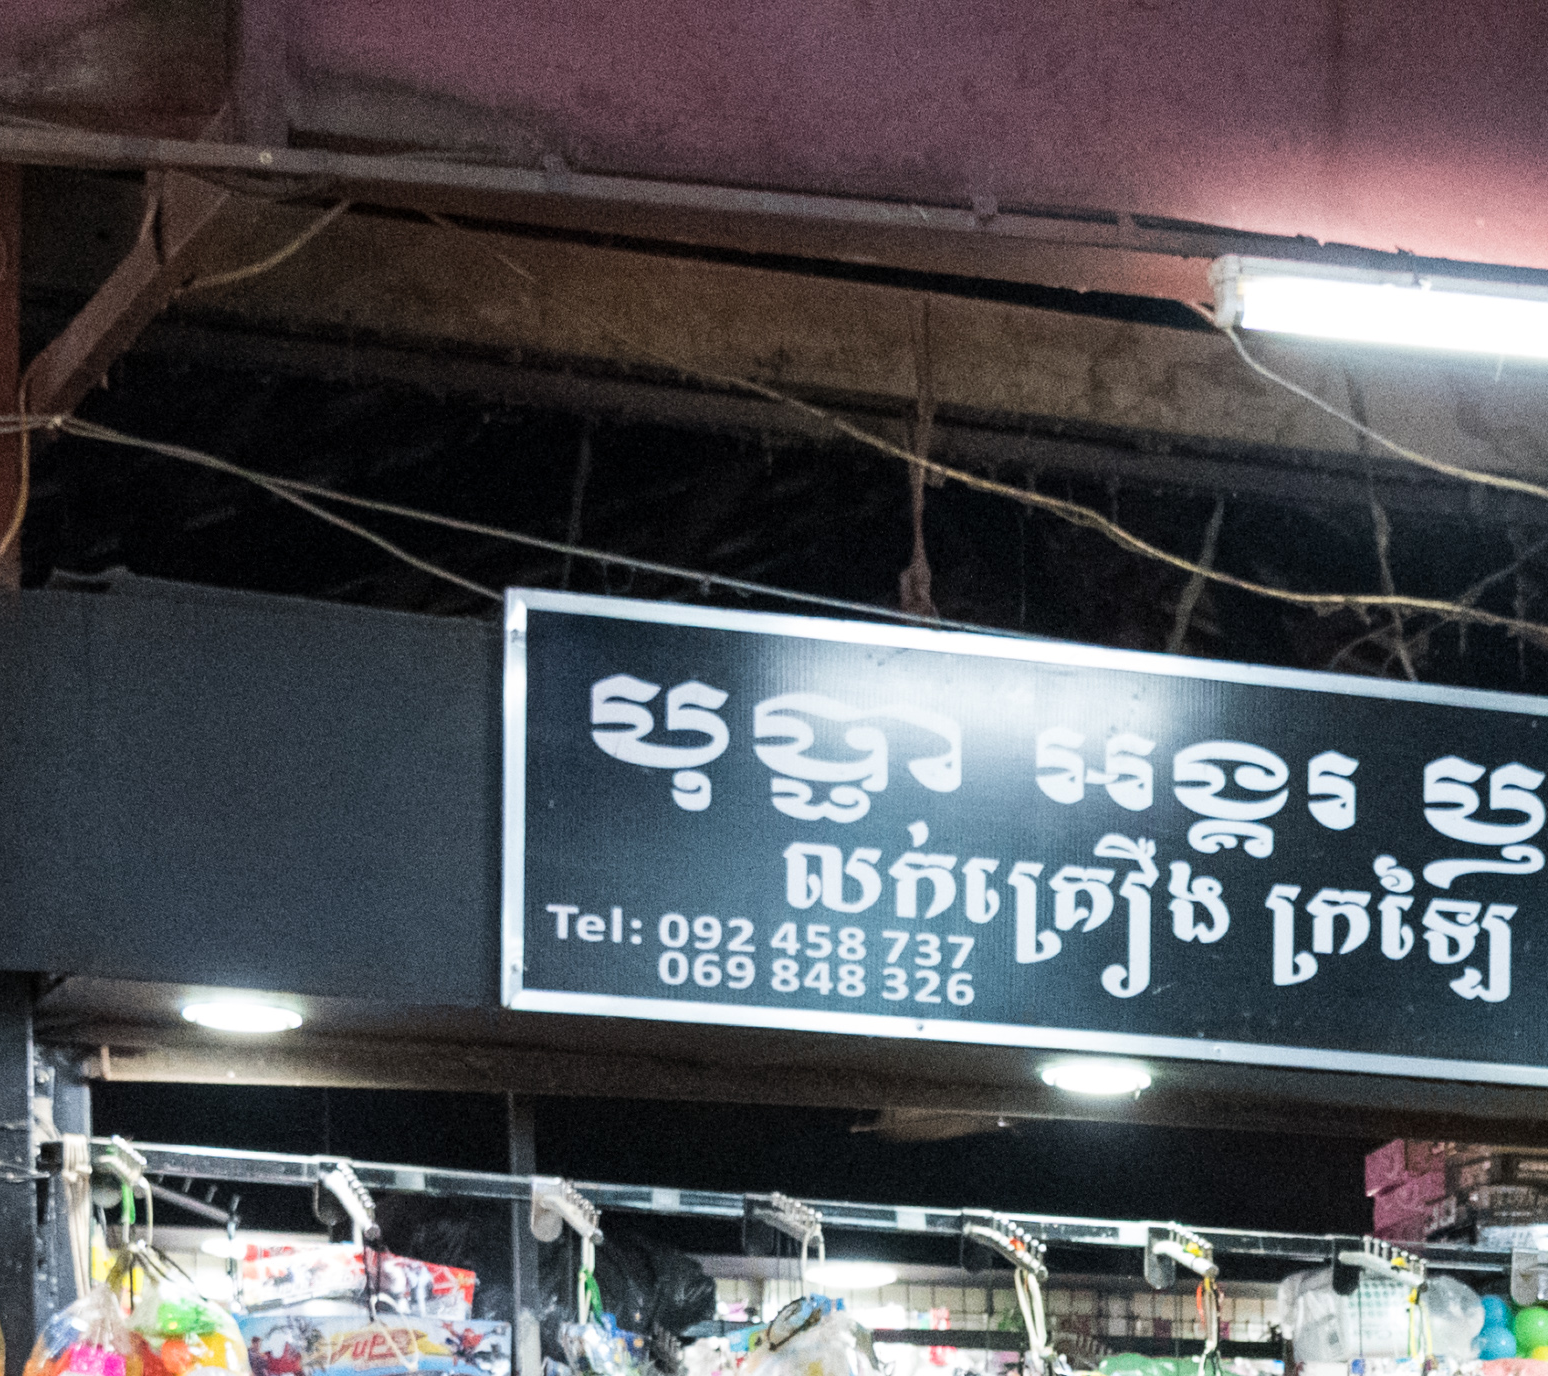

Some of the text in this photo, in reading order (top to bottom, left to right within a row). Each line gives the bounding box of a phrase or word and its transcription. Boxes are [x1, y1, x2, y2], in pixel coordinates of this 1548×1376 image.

[1035, 726, 1360, 859] អង្គរ
[546, 903, 976, 970] Tel: 092 458 737
[657, 950, 976, 1007] 069 848 326
